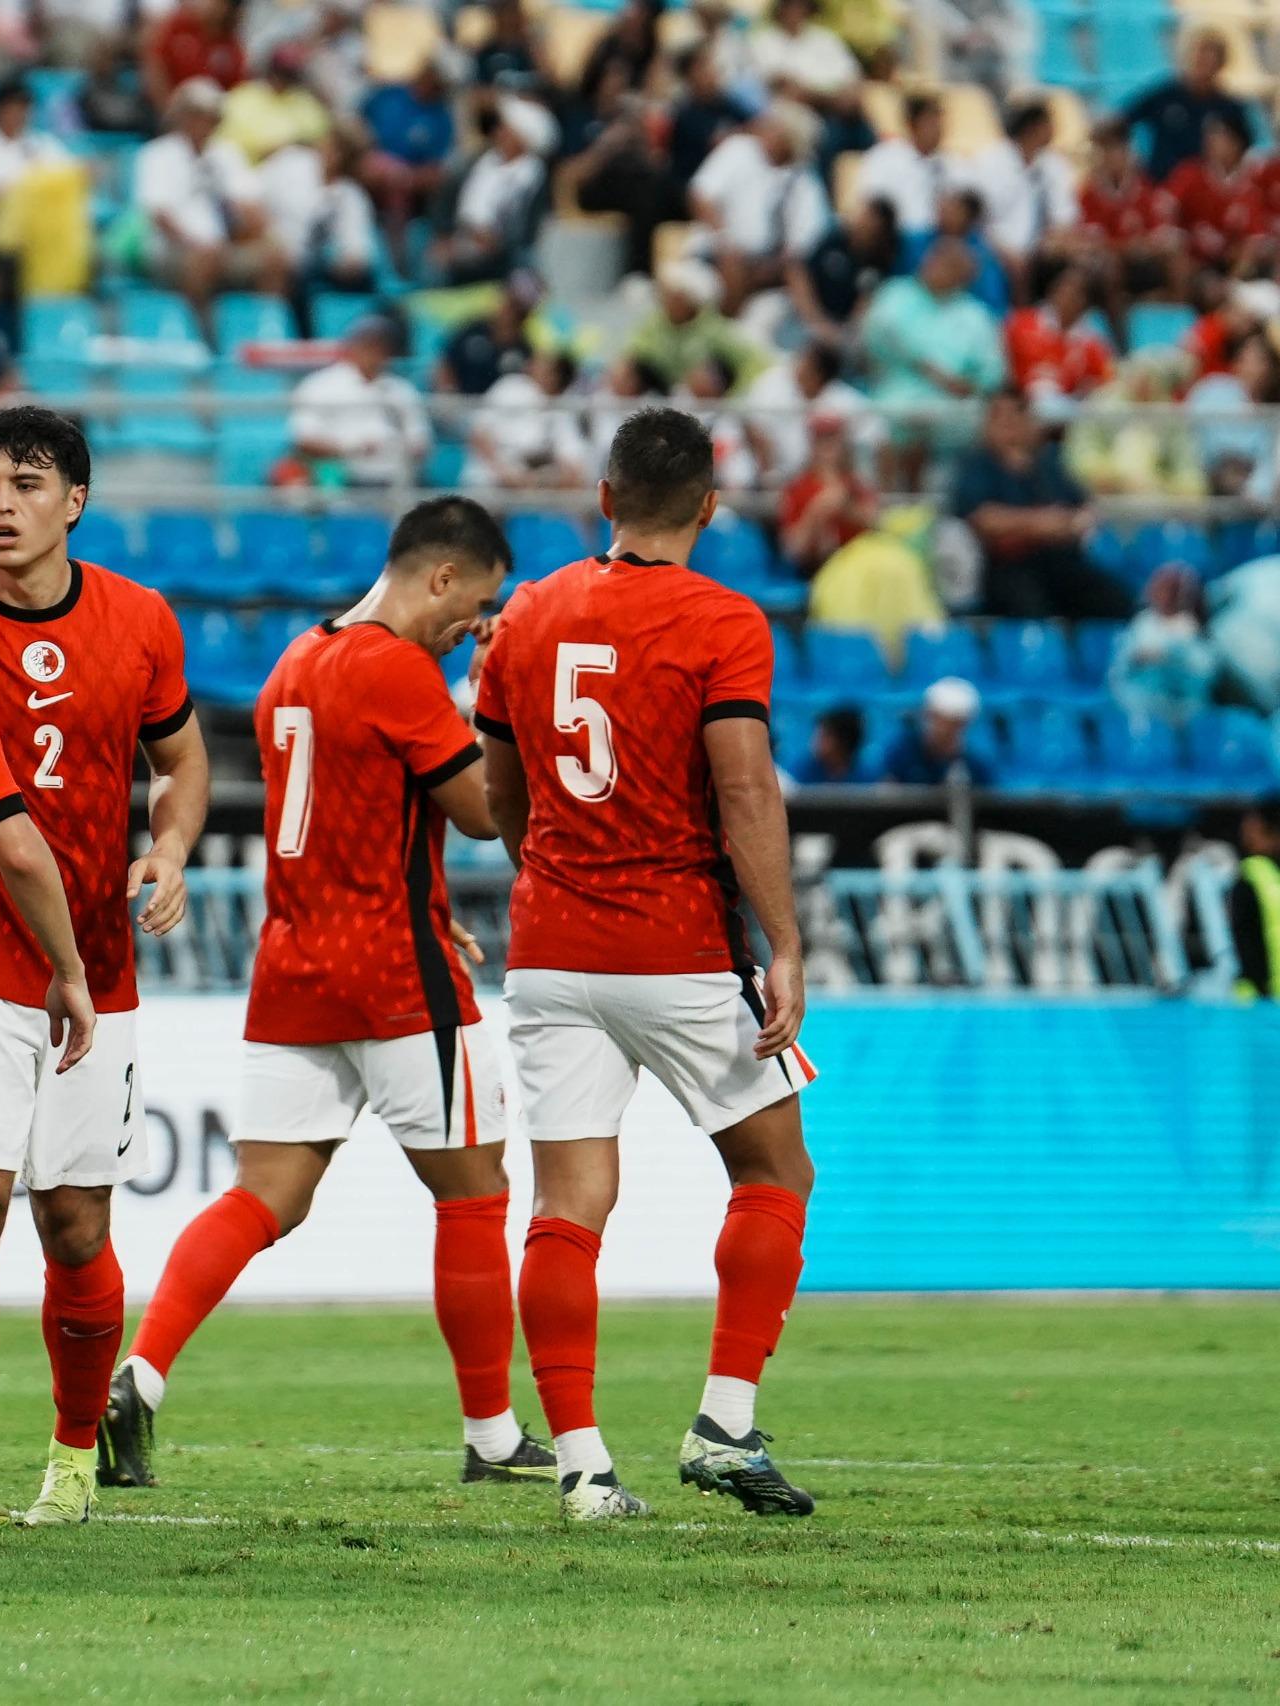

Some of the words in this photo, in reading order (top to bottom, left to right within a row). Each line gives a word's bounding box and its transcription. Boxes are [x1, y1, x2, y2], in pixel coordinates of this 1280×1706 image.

[34, 724, 64, 788] 2
[274, 706, 314, 858] 7
[554, 642, 618, 803] 5
